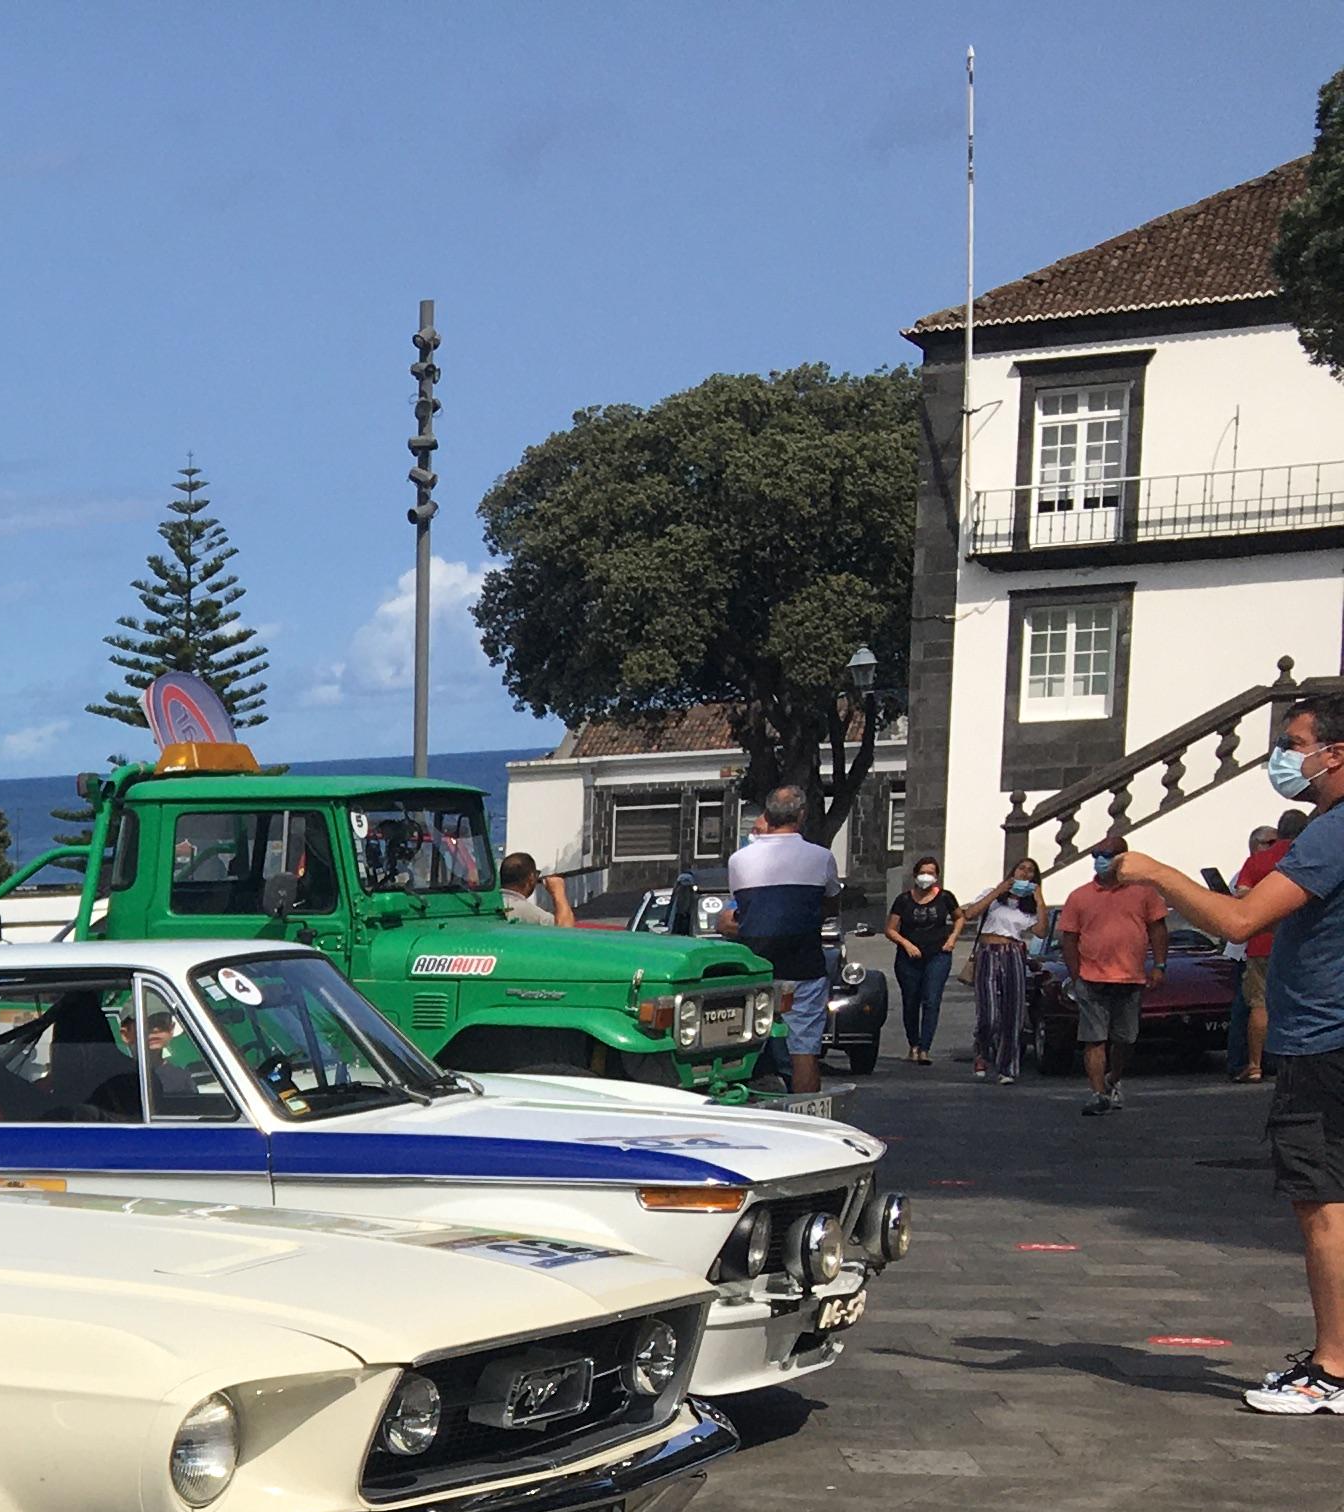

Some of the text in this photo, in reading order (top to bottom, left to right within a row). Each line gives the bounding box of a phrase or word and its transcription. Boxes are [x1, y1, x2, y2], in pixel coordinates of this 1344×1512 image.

[355, 815, 364, 828] 5
[414, 957, 494, 973] ADRIAUTO
[235, 979, 251, 993] 4
[705, 1009, 736, 1021] TOYOTA
